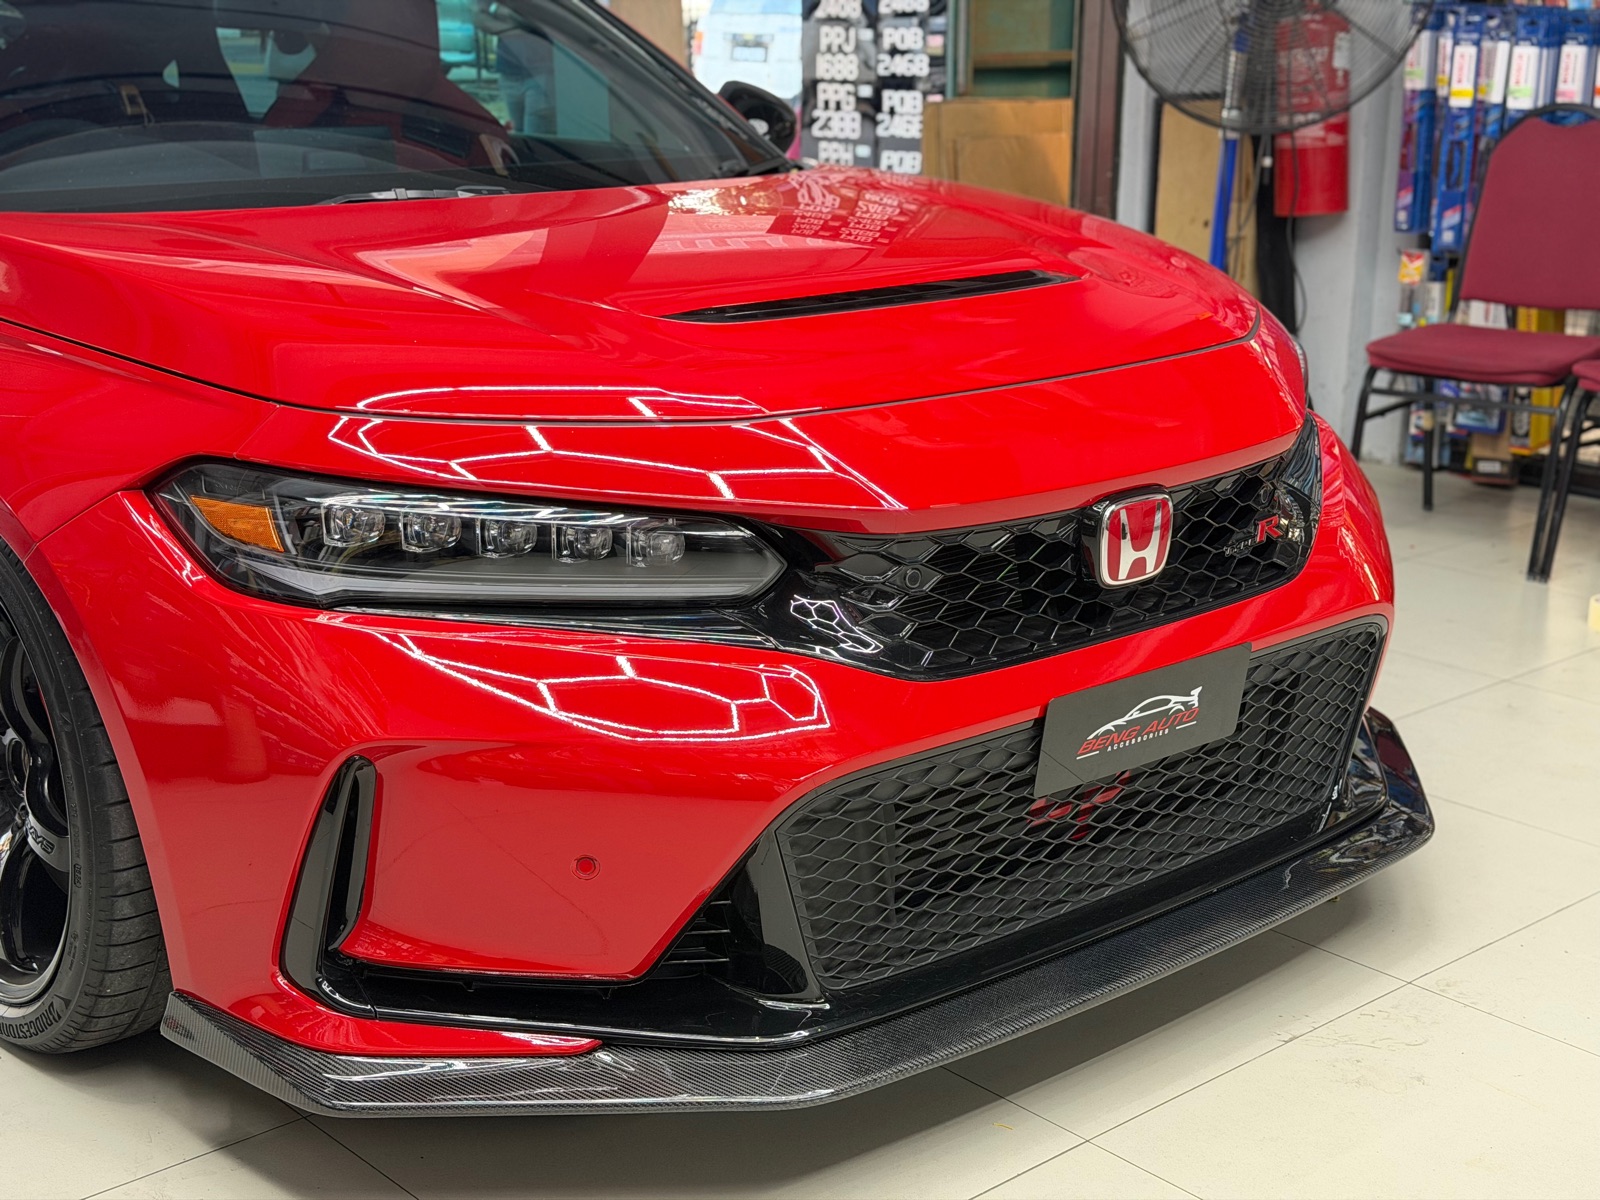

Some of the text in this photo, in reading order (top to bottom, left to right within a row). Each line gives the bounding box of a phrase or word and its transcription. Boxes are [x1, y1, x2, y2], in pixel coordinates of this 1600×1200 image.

[877, 53, 930, 77] 2468
[1256, 514, 1284, 543] R
[1077, 707, 1199, 755] BENG AUTO
[1107, 728, 1169, 752] ACCESSORIES
